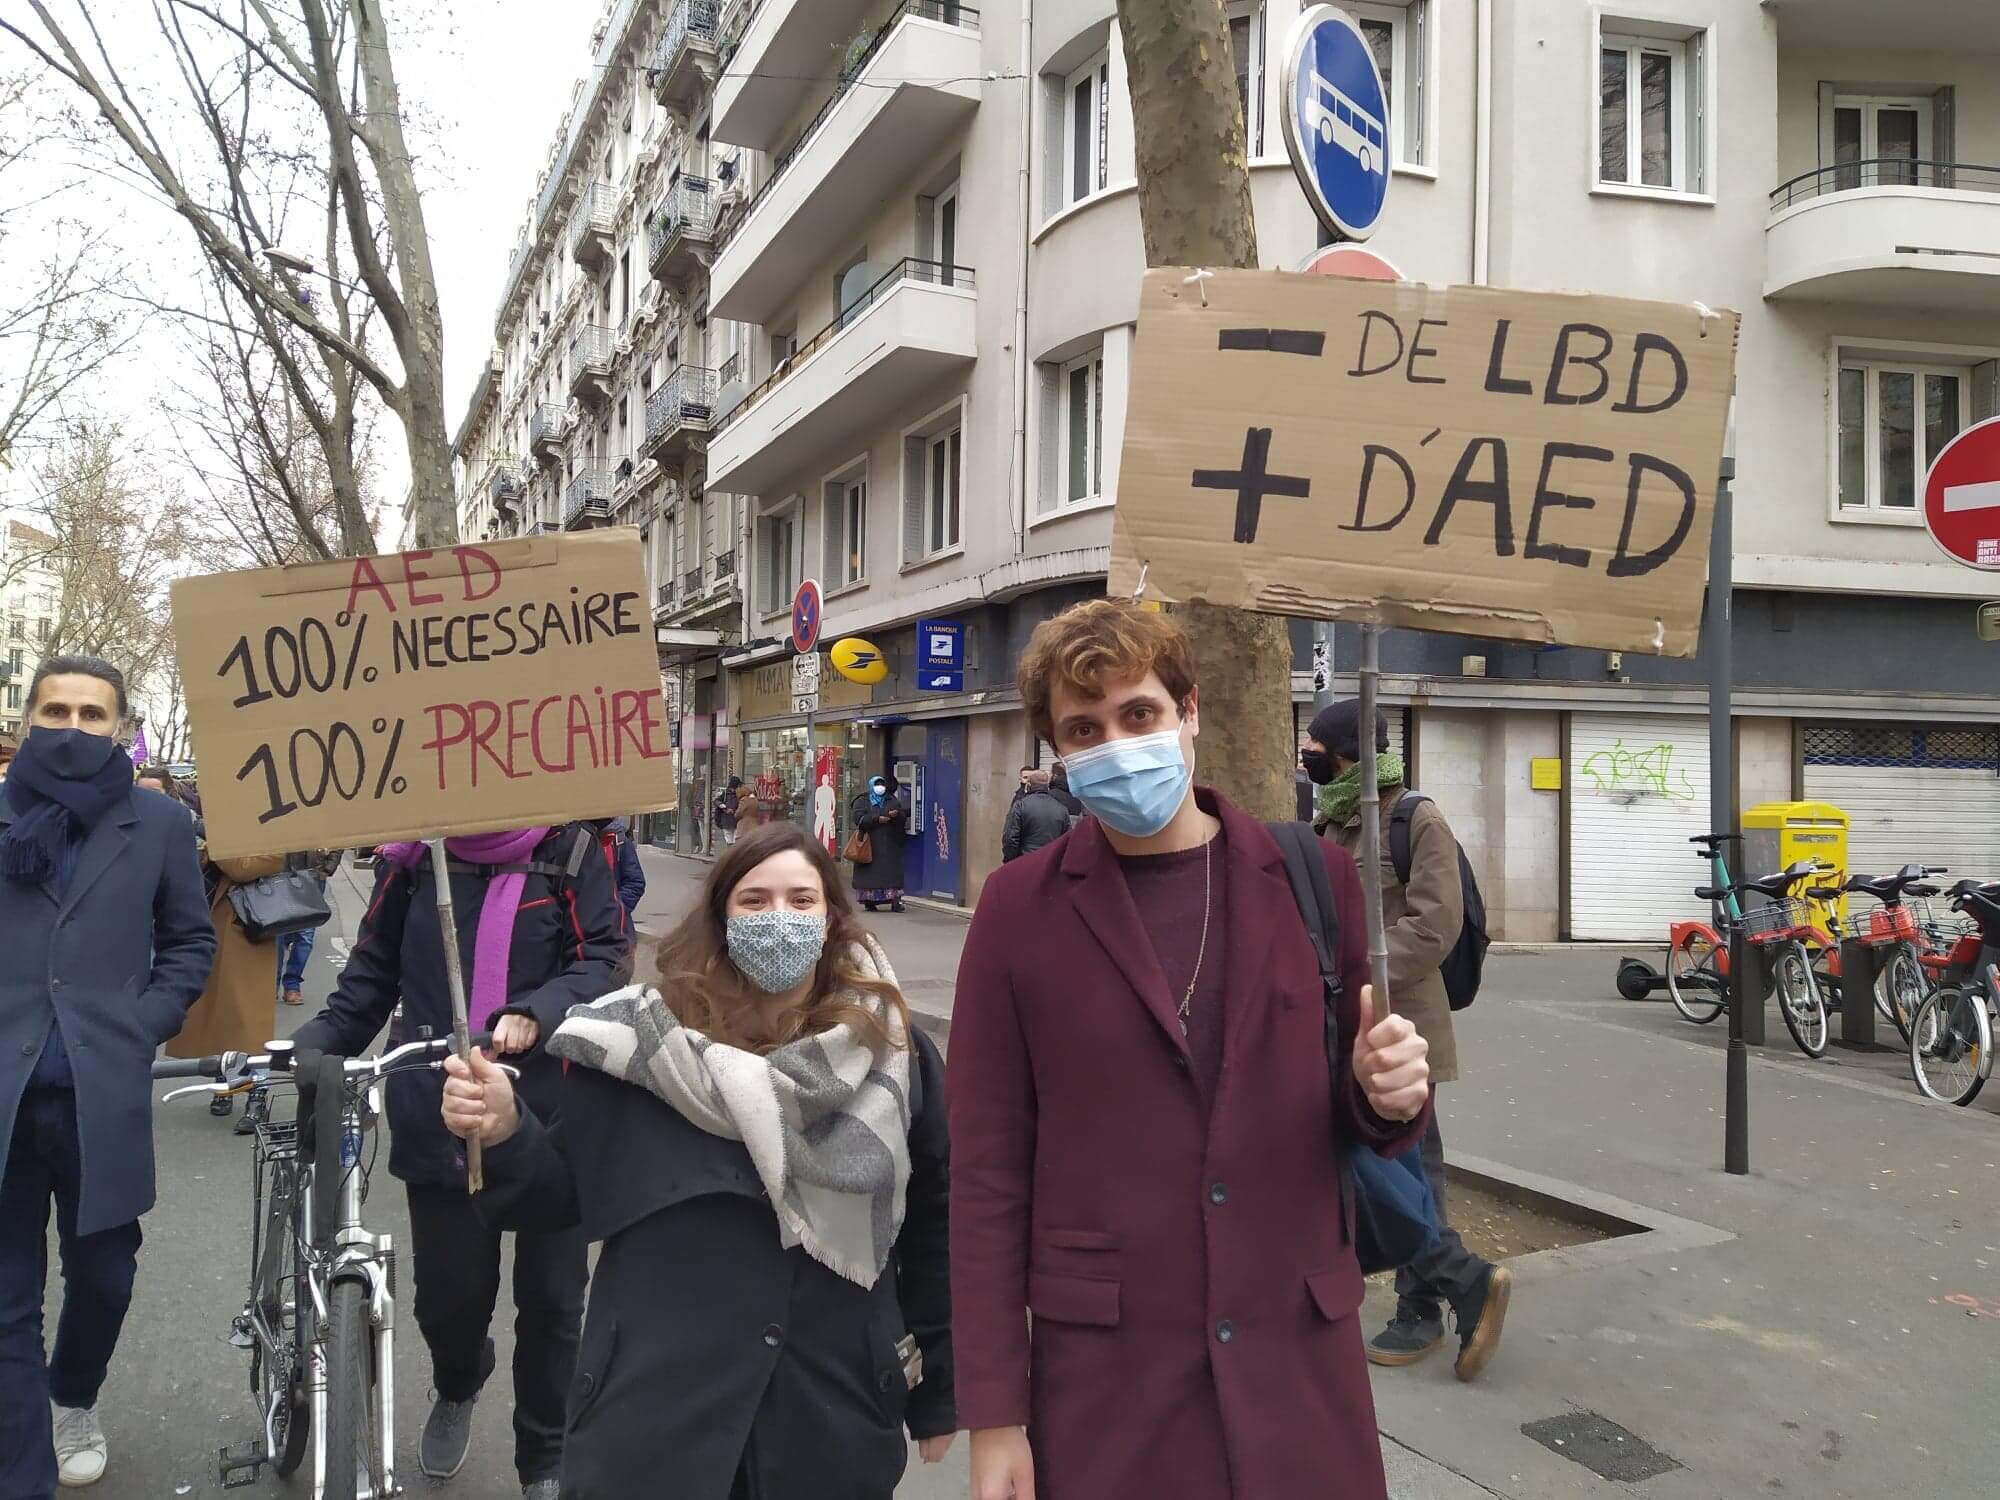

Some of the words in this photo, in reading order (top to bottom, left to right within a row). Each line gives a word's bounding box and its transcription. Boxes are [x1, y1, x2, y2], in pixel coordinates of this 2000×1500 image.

[1346, 309, 1449, 384] DE
[1484, 318, 1690, 414] LBD
[346, 545, 503, 614] AED
[216, 609, 379, 708] 100%
[392, 586, 641, 673] NECESSAIRE
[928, 657, 954, 665] POSTALE
[933, 626, 958, 634] BANQUE
[236, 717, 408, 824] 100%
[421, 686, 671, 790] PRECAIRE
